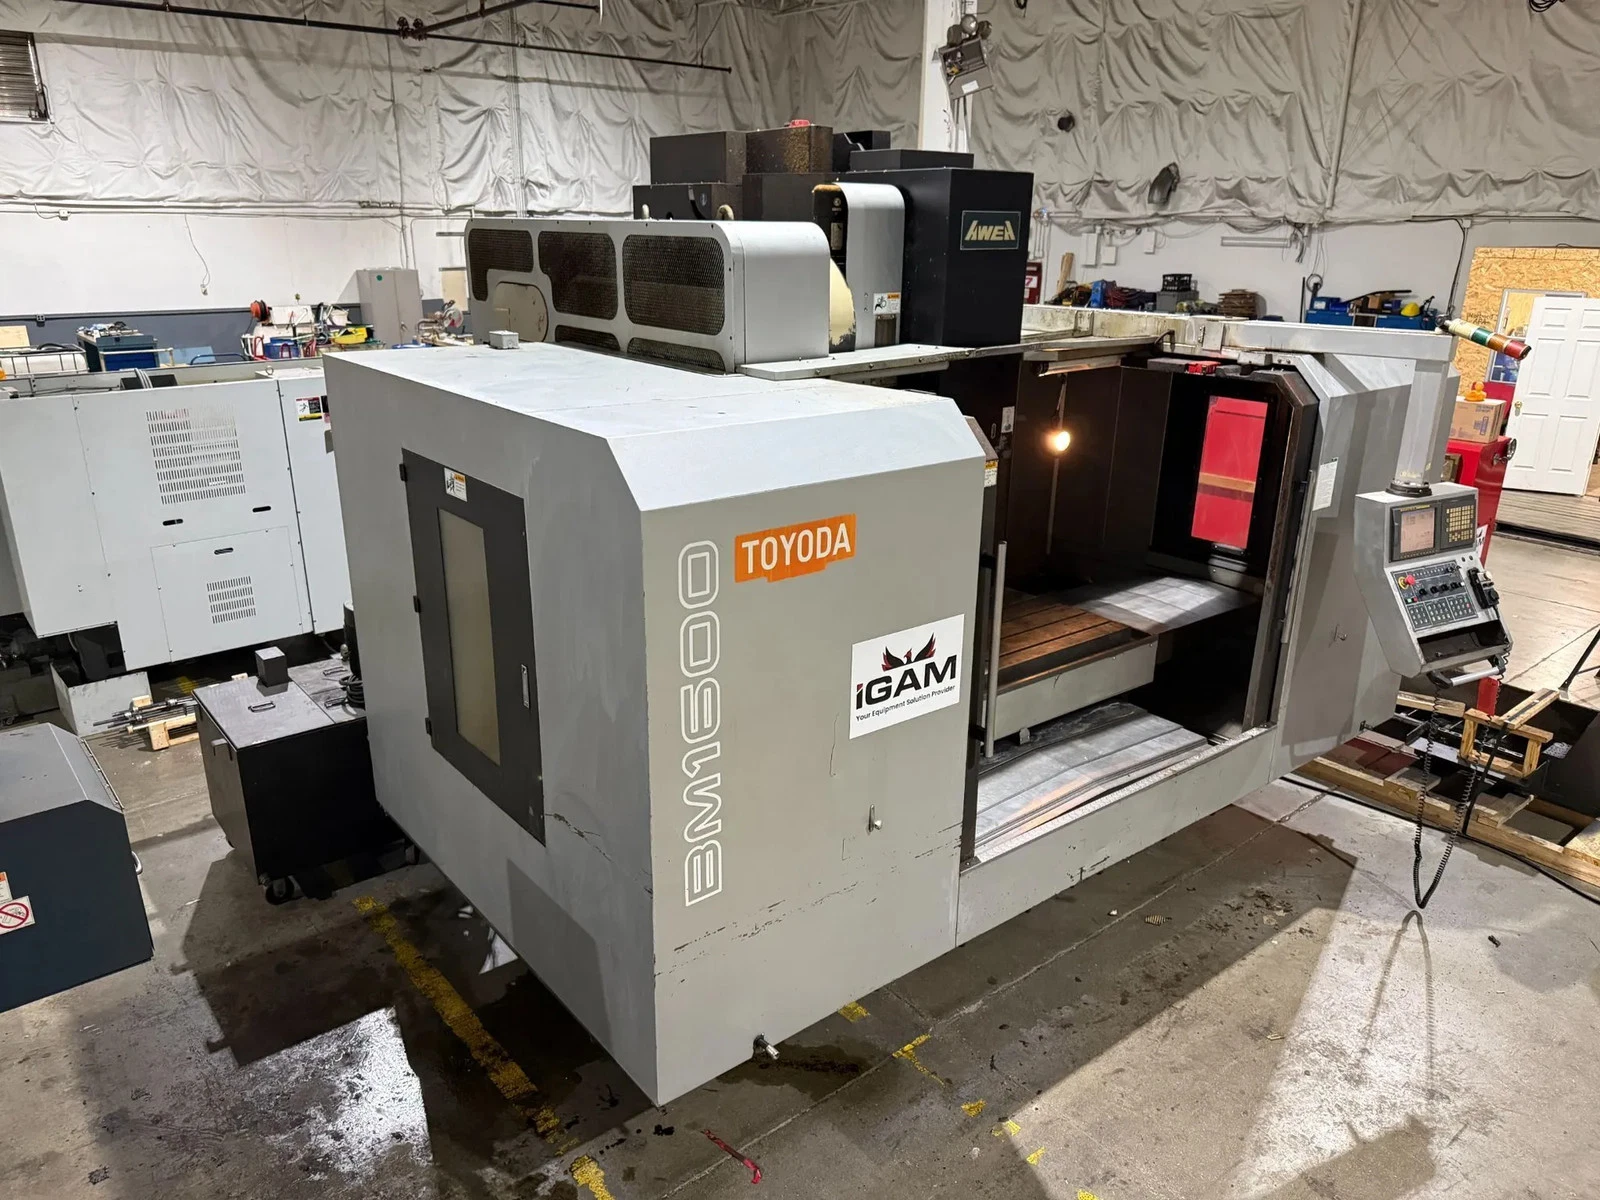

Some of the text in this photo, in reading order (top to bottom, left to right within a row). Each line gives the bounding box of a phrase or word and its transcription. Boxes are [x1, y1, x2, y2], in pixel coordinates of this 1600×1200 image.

[964, 220, 1016, 241] AWEA
[741, 522, 851, 574] TOYODA
[678, 540, 723, 906] BM1600
[856, 685, 956, 722] Your Equipment Solution Provider
